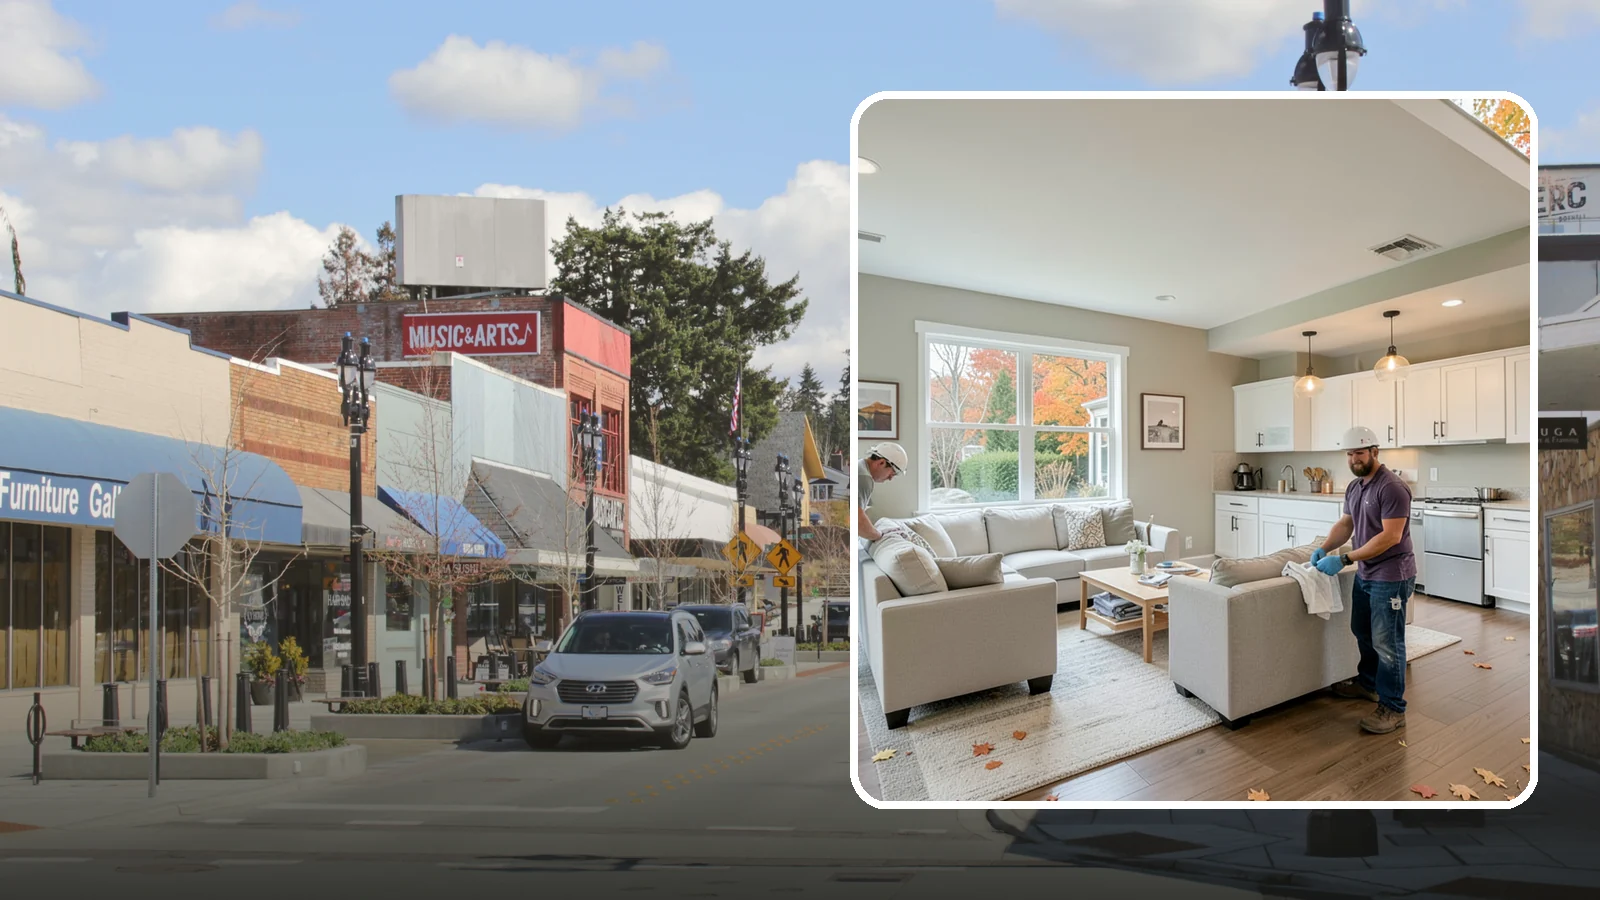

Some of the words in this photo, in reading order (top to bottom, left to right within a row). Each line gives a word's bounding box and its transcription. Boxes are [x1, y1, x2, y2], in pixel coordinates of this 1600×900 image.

[409, 323, 519, 349] MUSIC&ARTS
[1540, 427, 1577, 436] UGA
[0, 472, 79, 515] Furniture
[89, 482, 122, 519] Gal
[453, 563, 479, 575] SUSHI
